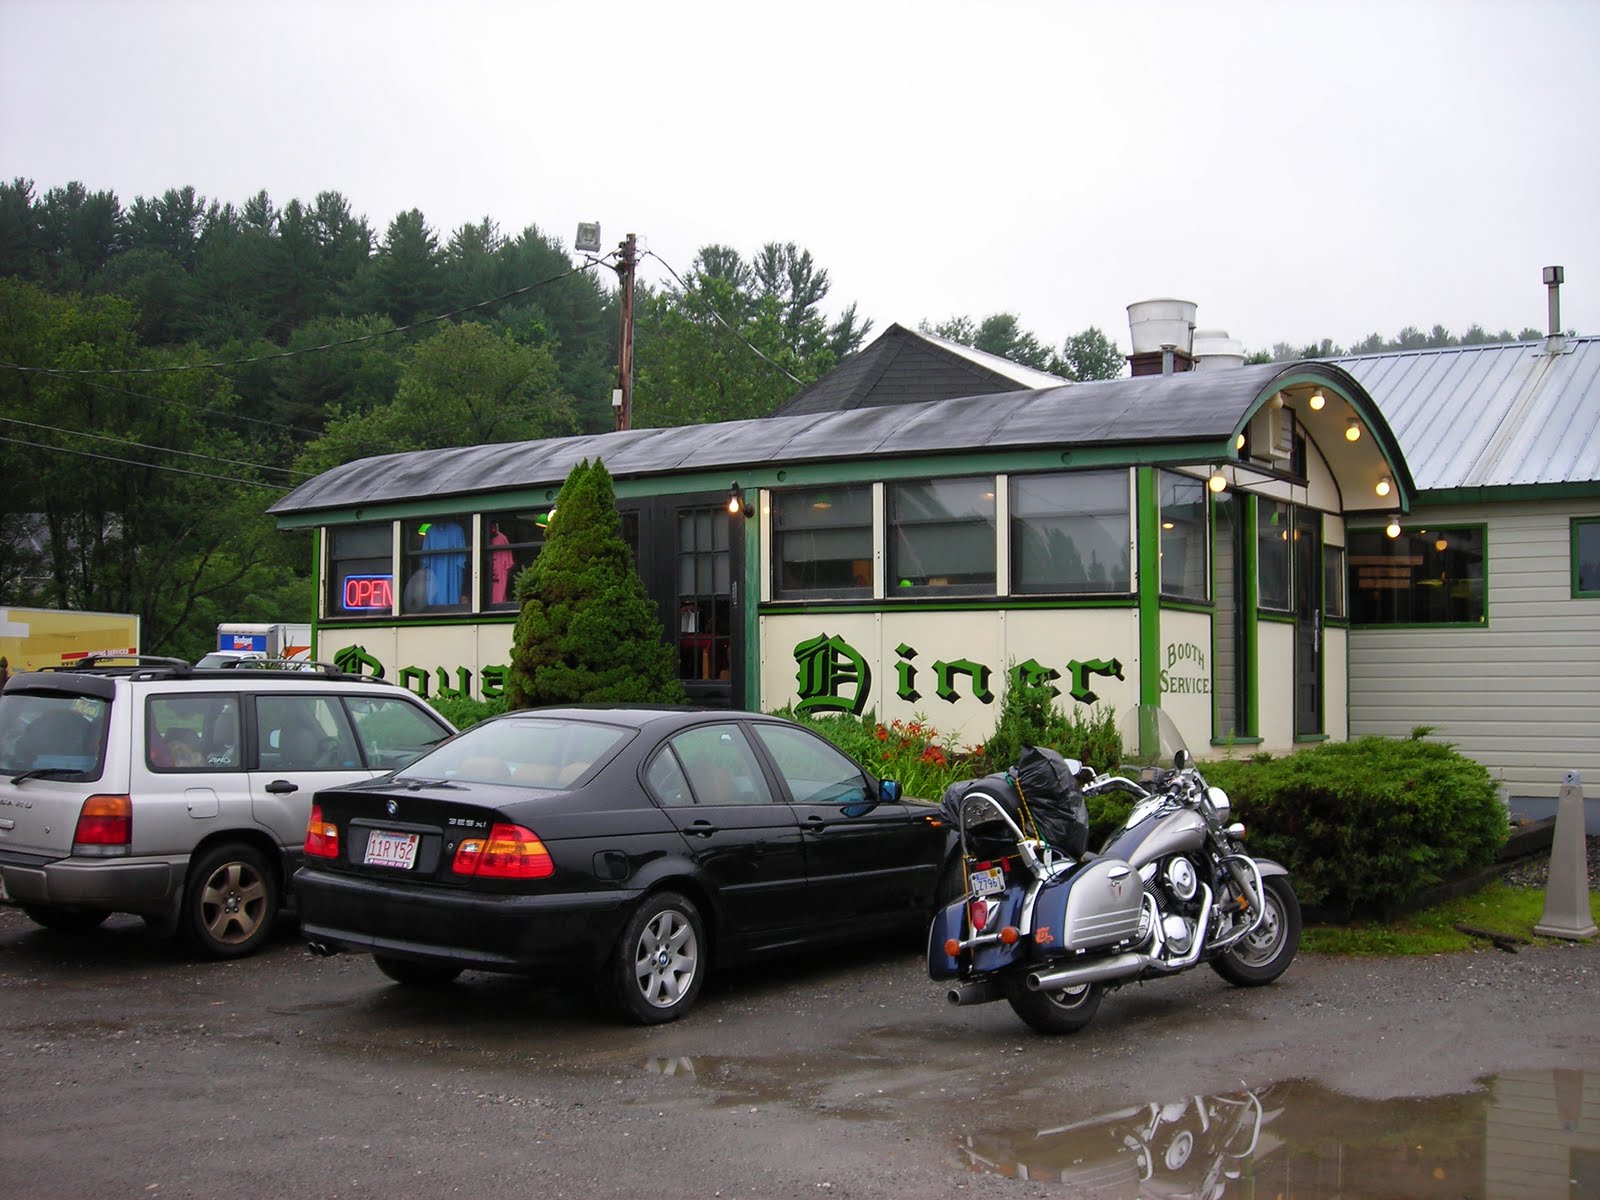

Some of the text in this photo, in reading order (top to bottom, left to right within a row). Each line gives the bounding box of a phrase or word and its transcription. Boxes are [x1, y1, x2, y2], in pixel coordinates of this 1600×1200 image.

[346, 580, 394, 606] OPEN
[1167, 642, 1205, 671] BOOTH
[793, 632, 1126, 717] Diner
[1160, 669, 1210, 694] SERVICE
